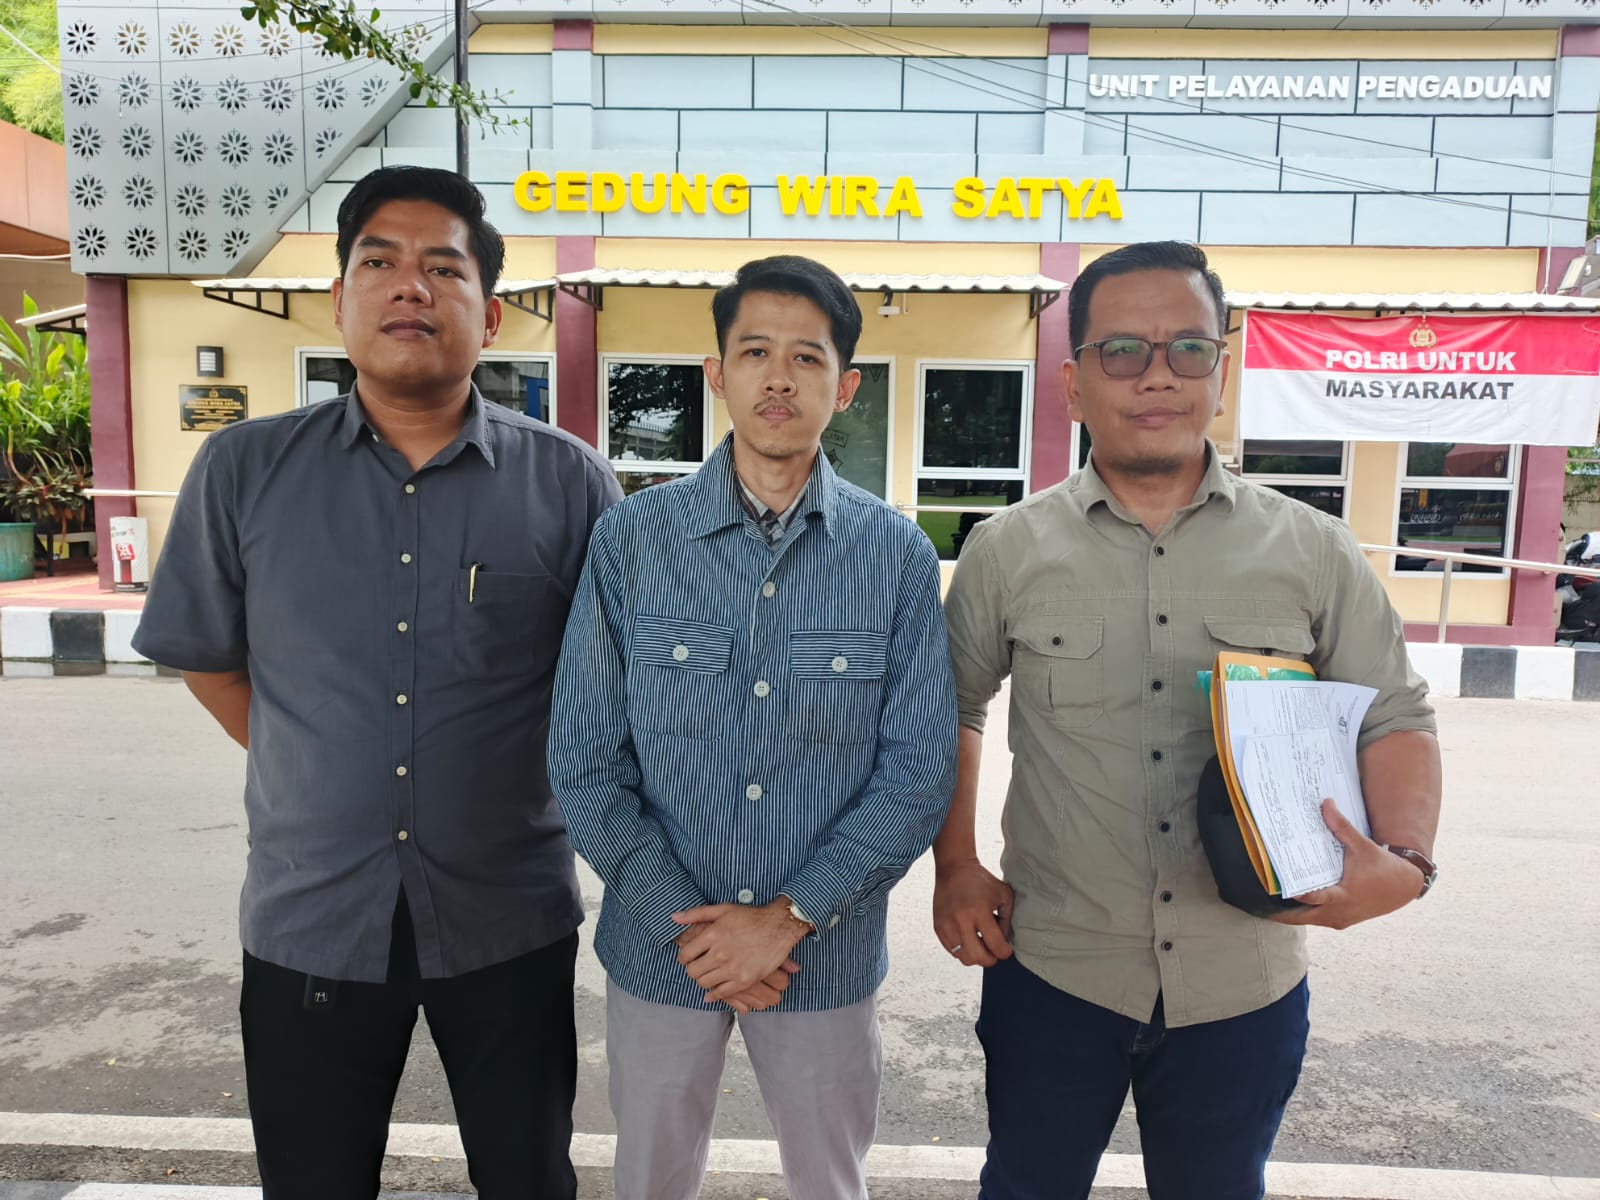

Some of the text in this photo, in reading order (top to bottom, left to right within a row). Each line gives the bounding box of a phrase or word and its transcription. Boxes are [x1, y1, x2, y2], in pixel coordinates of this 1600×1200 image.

[1089, 74, 1553, 99] UNIT PELAYANAN PENGADUAN
[513, 170, 1123, 219] GEDUNG WIRA SATYA
[1325, 349, 1516, 371] POLRI UNTUK
[1325, 378, 1515, 400] MASYARAKAT
